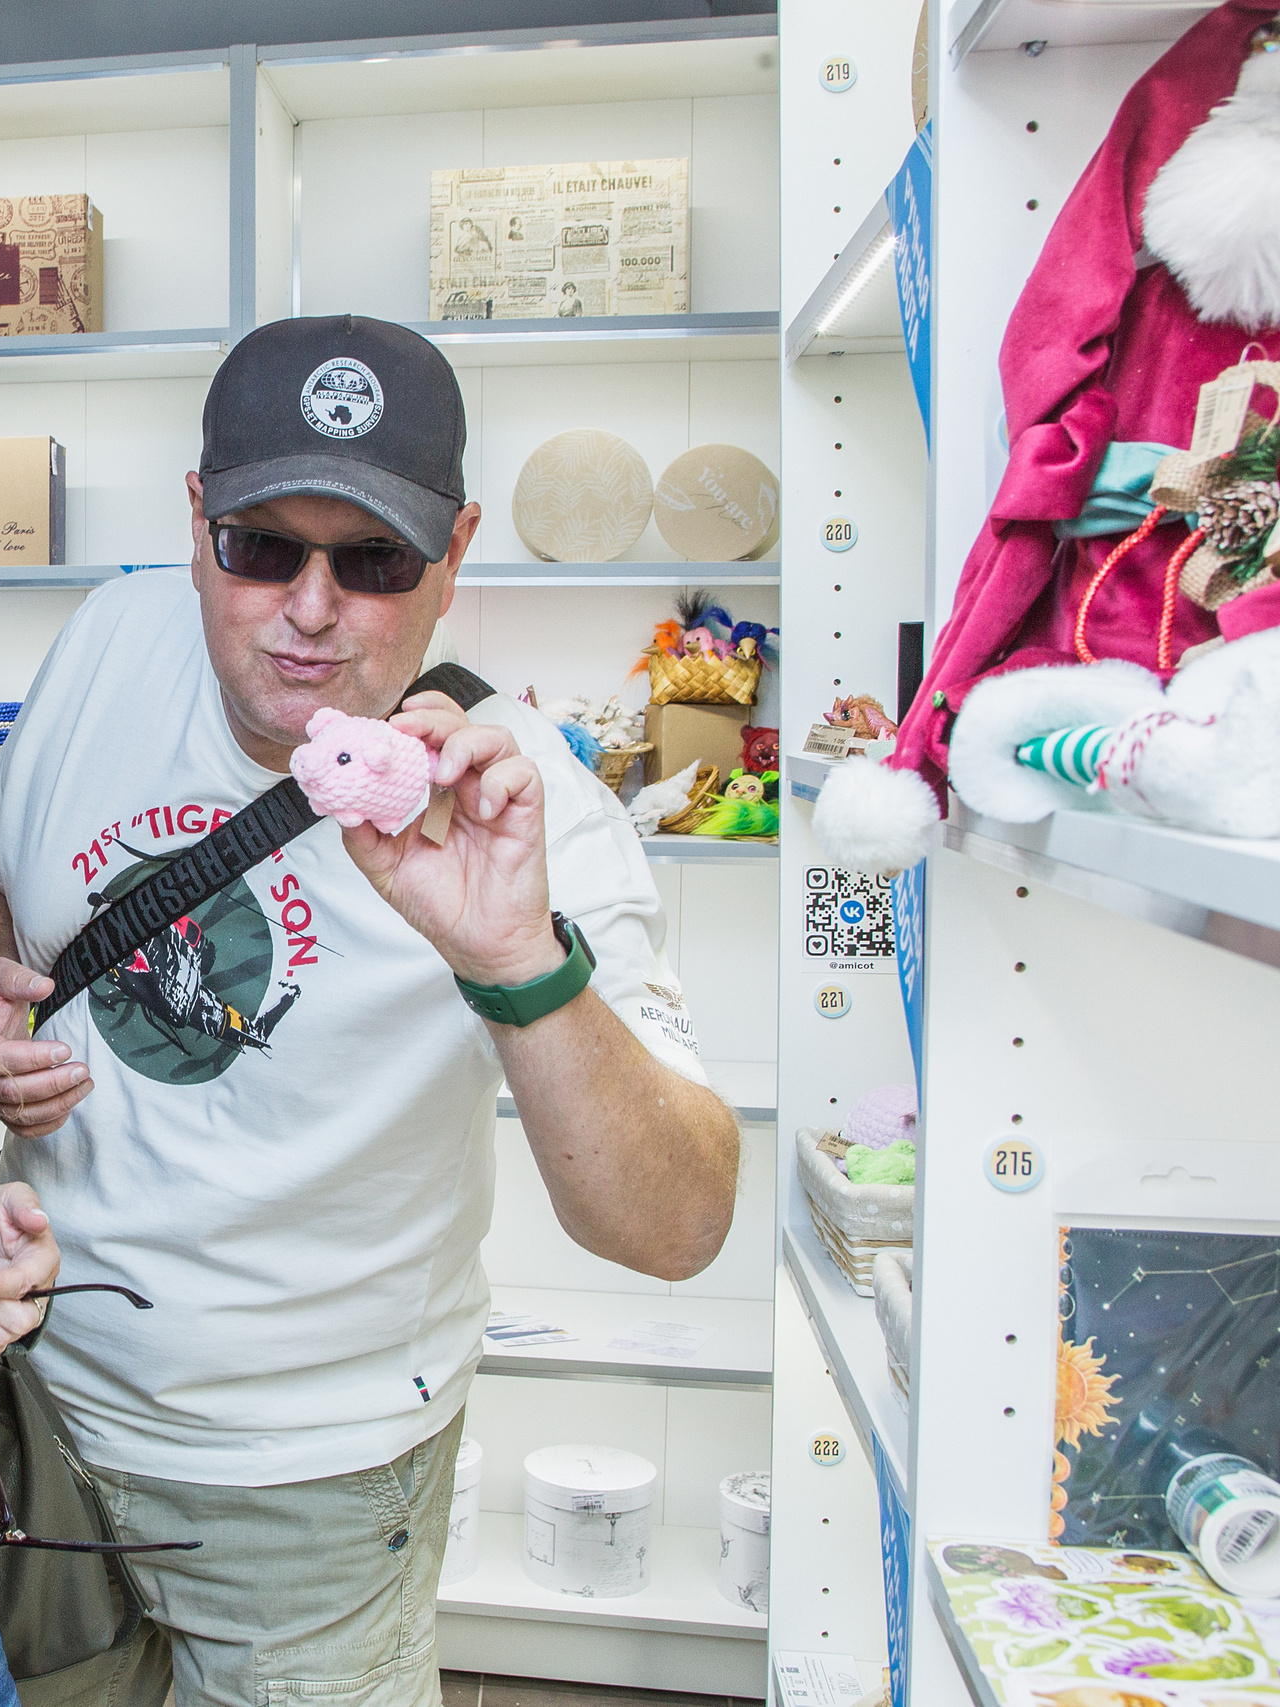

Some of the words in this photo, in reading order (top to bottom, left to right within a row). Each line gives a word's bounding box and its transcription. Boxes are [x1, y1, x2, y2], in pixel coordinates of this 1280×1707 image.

[826, 63, 850, 81] 219
[553, 181, 564, 194] IL
[601, 176, 653, 191] CHAUVE!
[904, 167, 930, 319] РУЧНАЯ
[620, 256, 661, 267] 100.000
[897, 225, 919, 362] РАБОТА
[305, 363, 331, 394] ANTARCTIC
[331, 360, 367, 373] RESEARCH
[365, 372, 381, 403] PROGRAM
[315, 422, 355, 437] MAPPING
[356, 405, 382, 434] SURVEYS
[1, 521, 36, 536] Paris
[826, 523, 852, 541] 220
[3, 540, 26, 552] love
[71, 820, 122, 886] 21ST
[270, 873, 319, 978] SQN.
[894, 871, 916, 1004] АБОТА
[829, 962, 875, 970] @amicot
[821, 991, 845, 1008] 221
[996, 1150, 1032, 1176] 215
[814, 1440, 839, 1456] 222
[882, 1522, 900, 1702] РАБОТА
